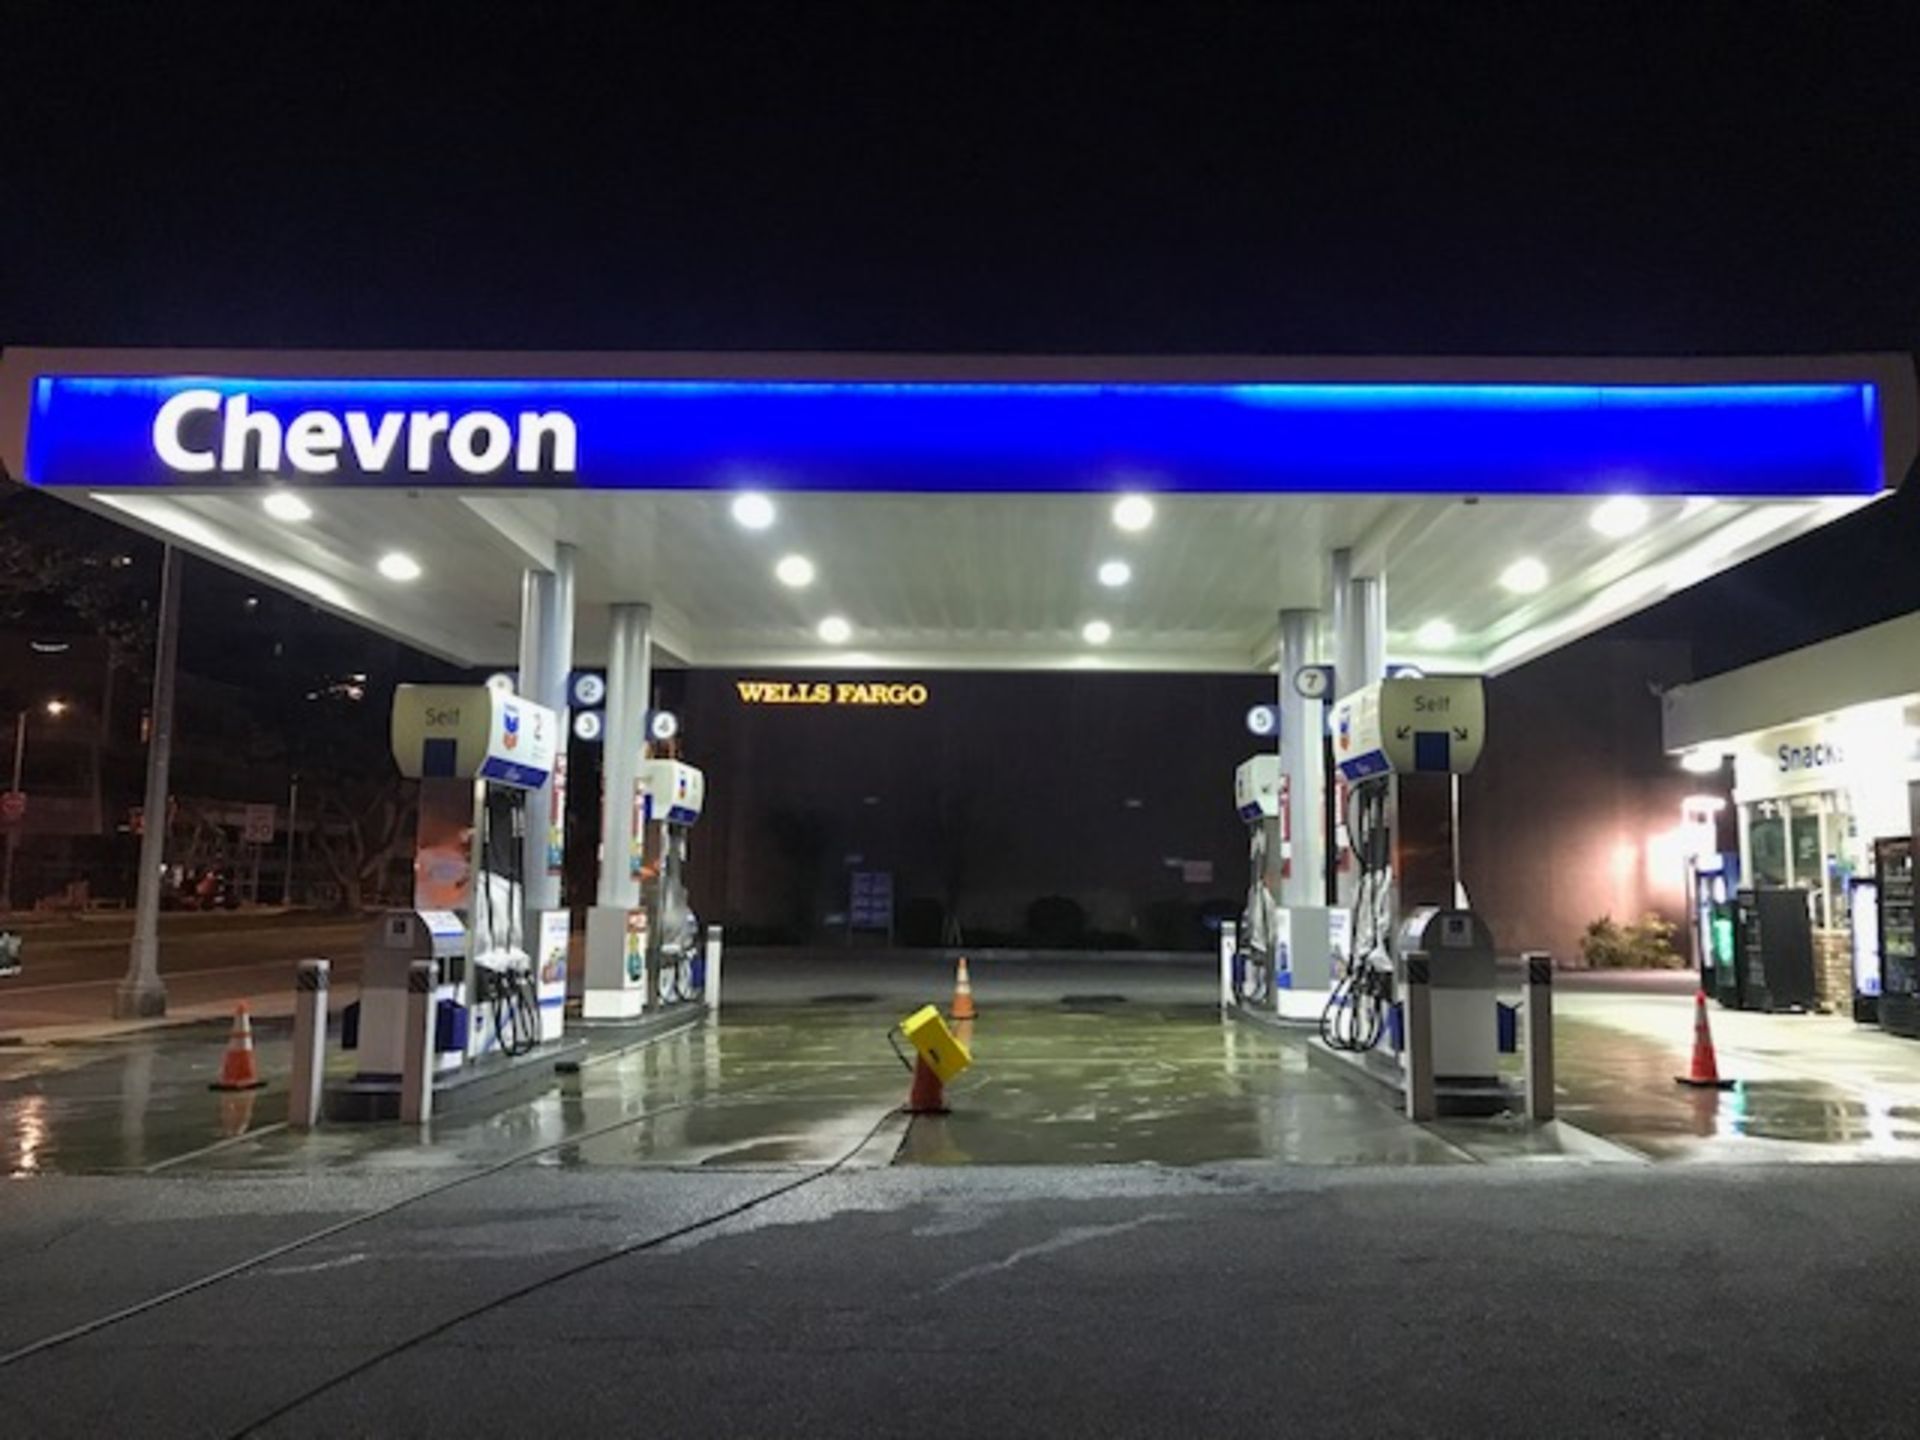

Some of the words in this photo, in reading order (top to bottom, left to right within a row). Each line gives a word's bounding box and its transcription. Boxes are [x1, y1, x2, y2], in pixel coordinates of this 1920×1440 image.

[153, 389, 576, 473] Chevron
[581, 680, 596, 699] 2
[1305, 674, 1318, 689] 7
[737, 682, 831, 704] WELLS
[835, 684, 928, 705] FARGO
[1414, 696, 1451, 713] Self
[424, 708, 461, 727] Self
[583, 717, 595, 734] 3
[658, 717, 670, 734] 4
[1256, 711, 1267, 728] 5
